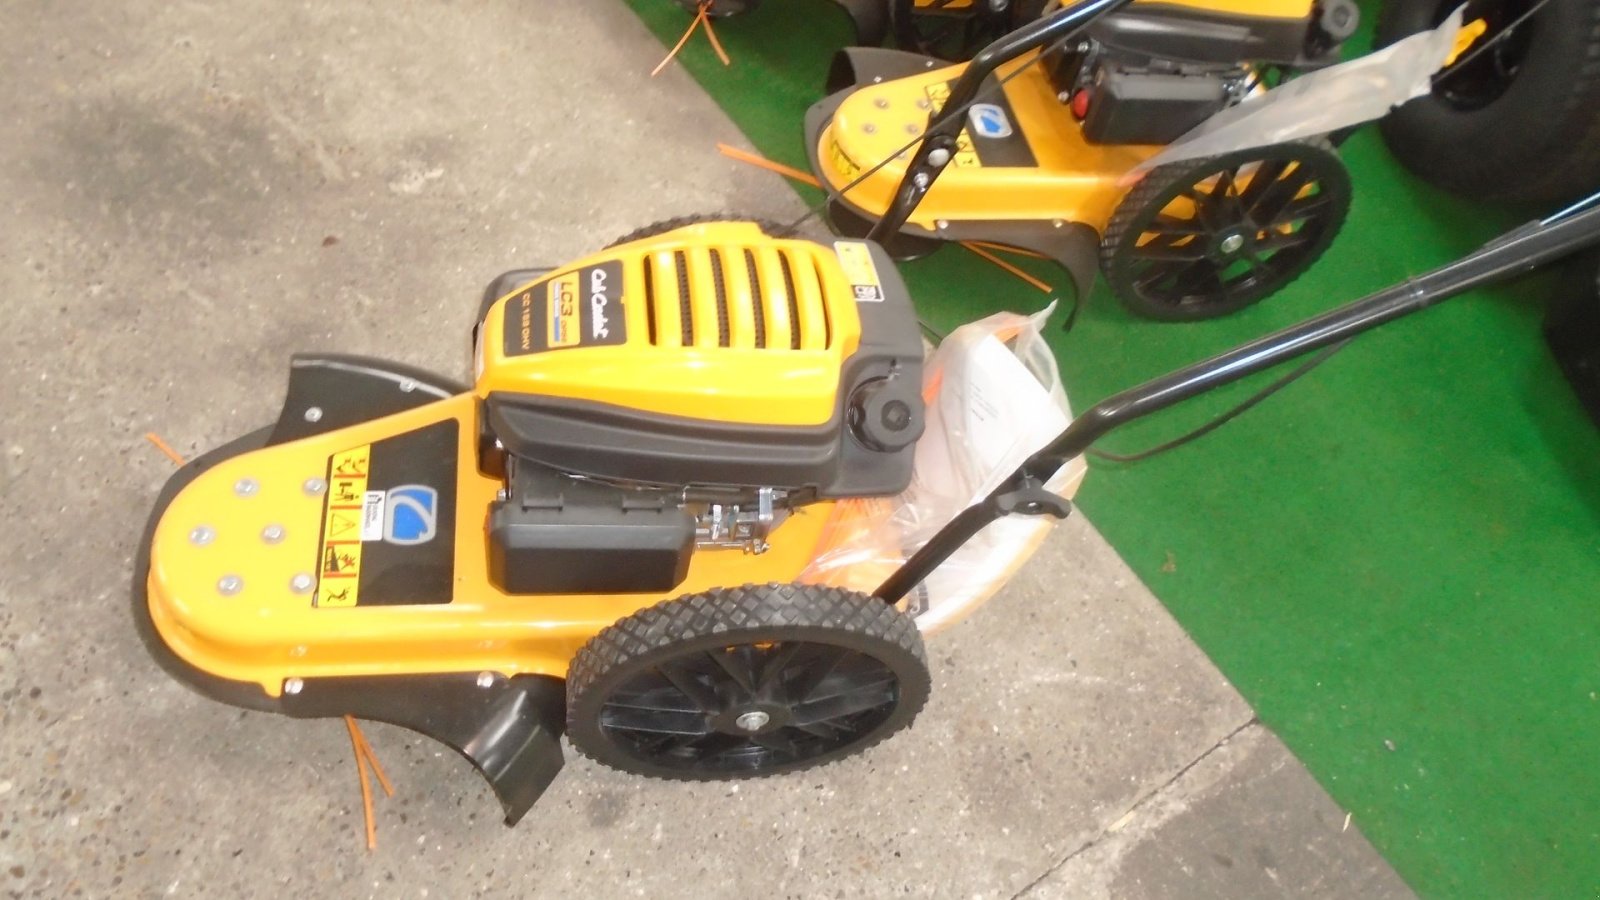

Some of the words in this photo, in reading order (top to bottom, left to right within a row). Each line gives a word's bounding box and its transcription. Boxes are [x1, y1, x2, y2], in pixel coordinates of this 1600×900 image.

[522, 292, 530, 307] CC
[560, 281, 573, 316] LC3
[521, 327, 531, 350] OHV
